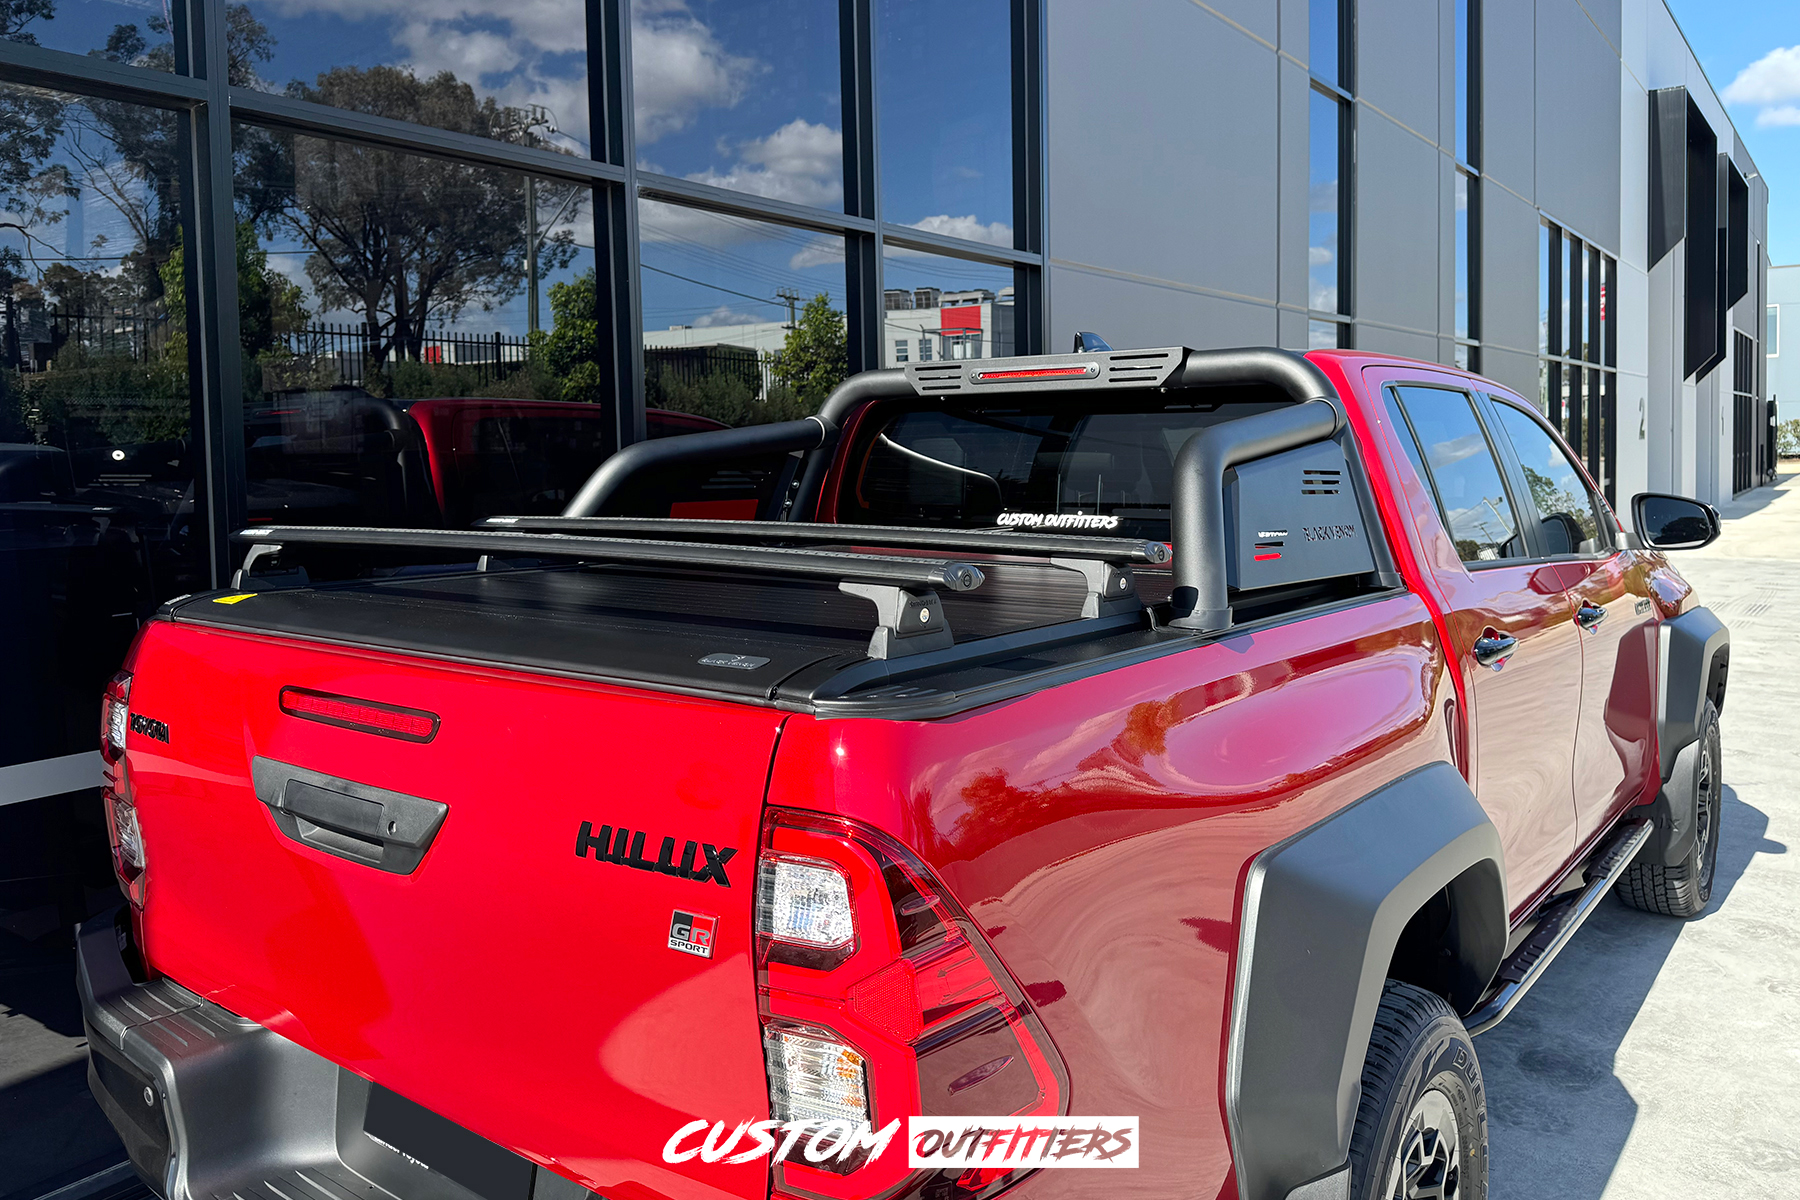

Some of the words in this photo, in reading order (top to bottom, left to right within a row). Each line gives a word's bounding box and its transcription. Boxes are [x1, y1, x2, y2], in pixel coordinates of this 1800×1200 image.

[1638, 397, 1646, 440] 2
[997, 512, 1043, 526] CUSTOM
[1044, 510, 1119, 529] OUTFITTERS
[130, 712, 170, 744] TOYOTA
[575, 820, 738, 888] HILUX
[669, 938, 708, 955] SPORT
[671, 922, 711, 946] GR
